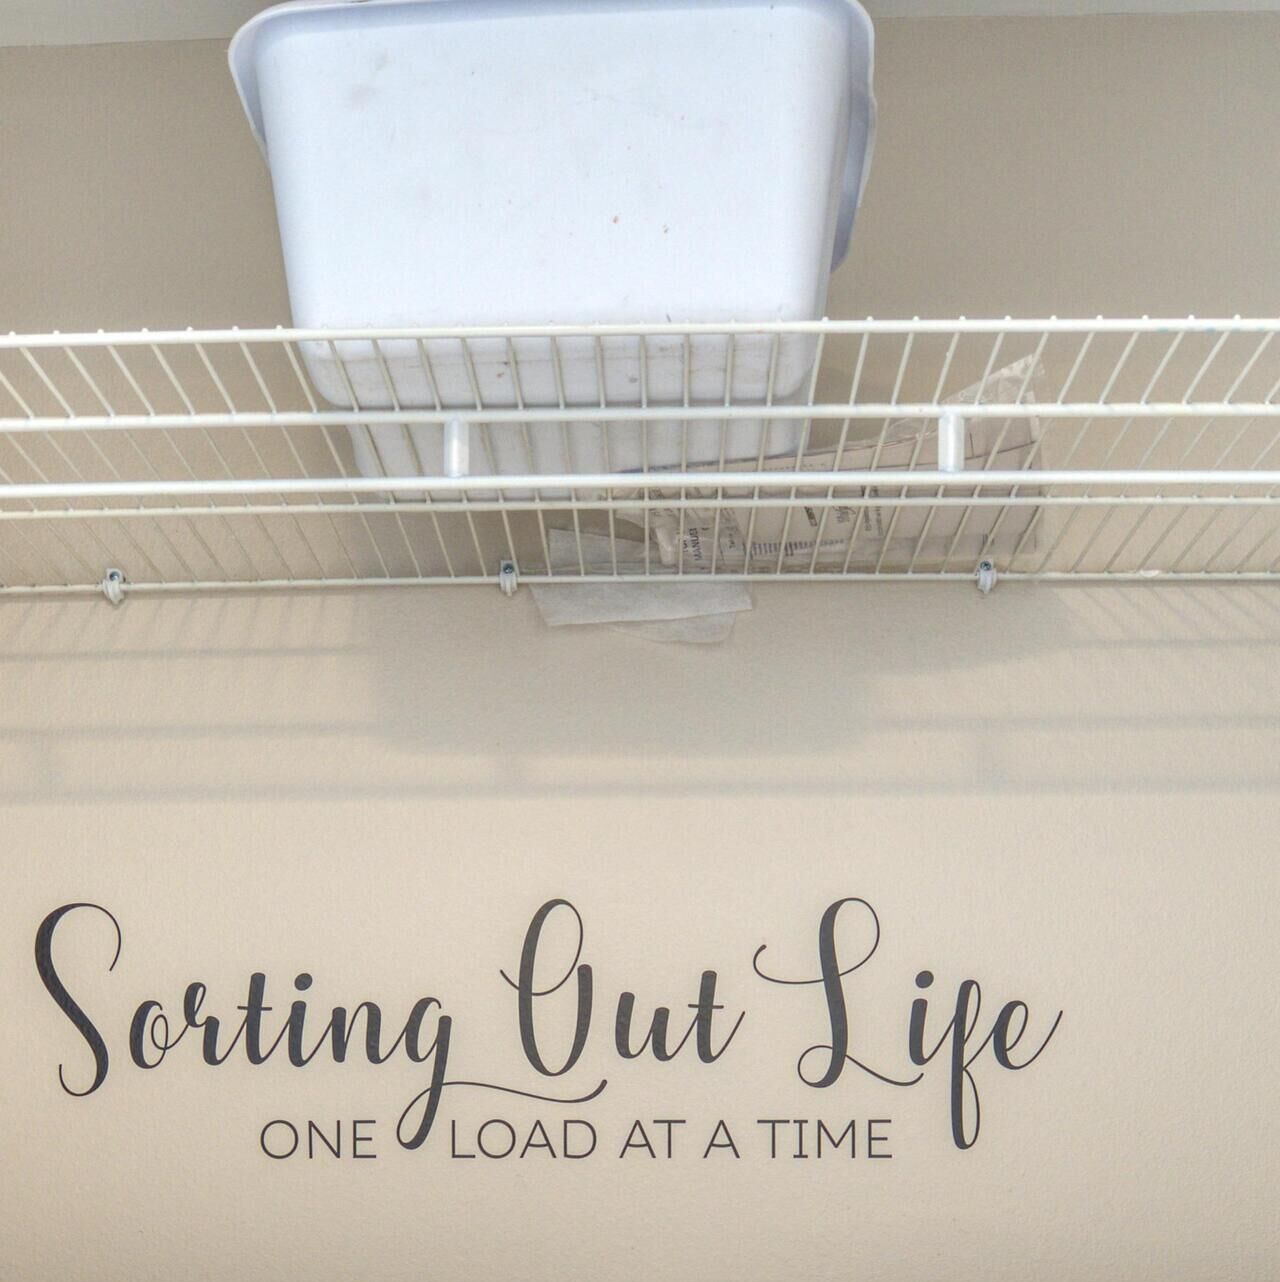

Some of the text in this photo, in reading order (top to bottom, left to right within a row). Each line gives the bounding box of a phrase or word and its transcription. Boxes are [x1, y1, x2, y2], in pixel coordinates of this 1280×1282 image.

[35, 897, 1065, 1151] Sorting Out Life
[260, 1119, 893, 1160] ONE LOAD AT A TIME
